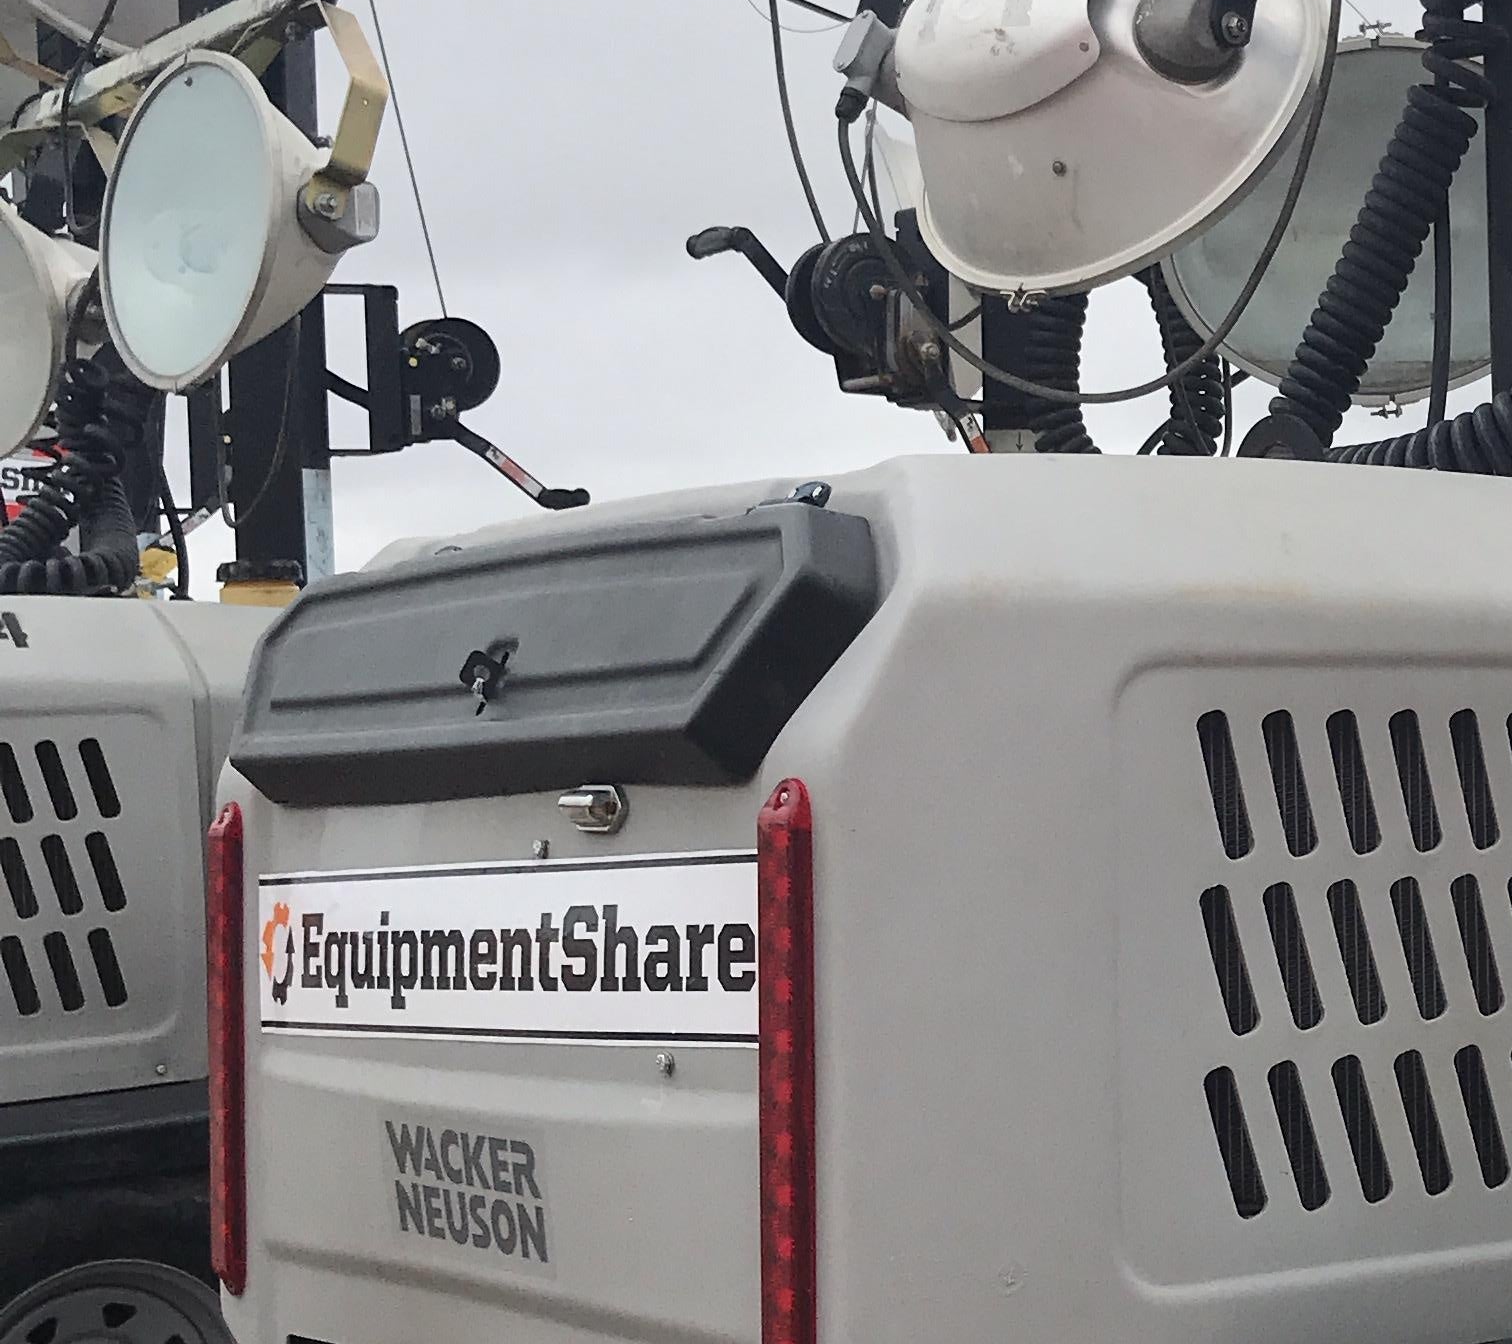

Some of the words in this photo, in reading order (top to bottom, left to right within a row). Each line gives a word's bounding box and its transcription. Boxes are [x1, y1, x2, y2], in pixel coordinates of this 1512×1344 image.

[301, 904, 757, 1010] EquipmentShare
[385, 1120, 542, 1200] WACKER
[395, 1179, 549, 1264] NEUSON
